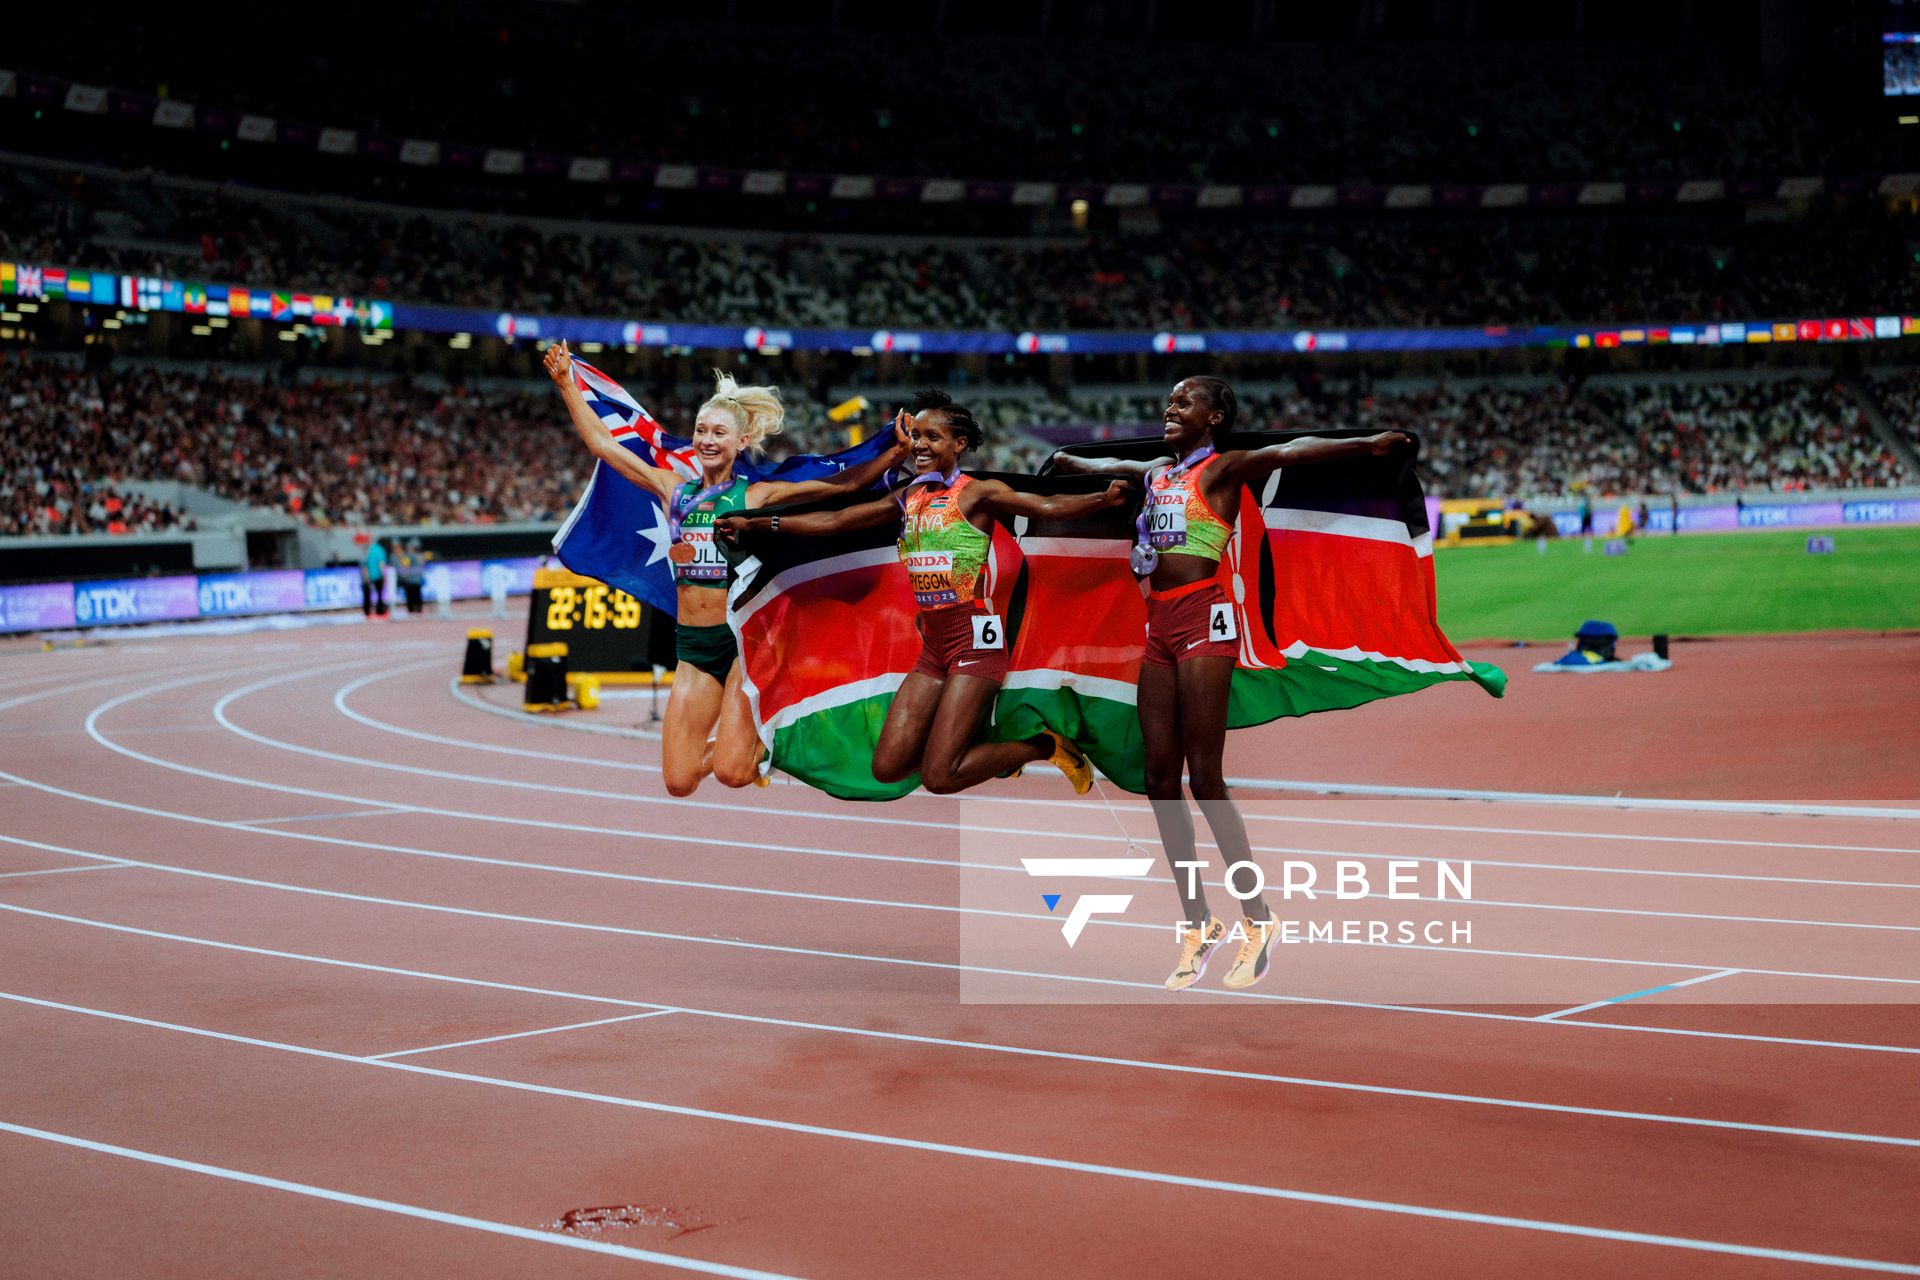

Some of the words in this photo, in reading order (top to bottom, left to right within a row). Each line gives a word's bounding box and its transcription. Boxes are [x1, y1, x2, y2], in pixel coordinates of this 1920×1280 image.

[90, 588, 138, 619] TDK
[982, 620, 997, 645] 6
[1212, 610, 1228, 636] 4
